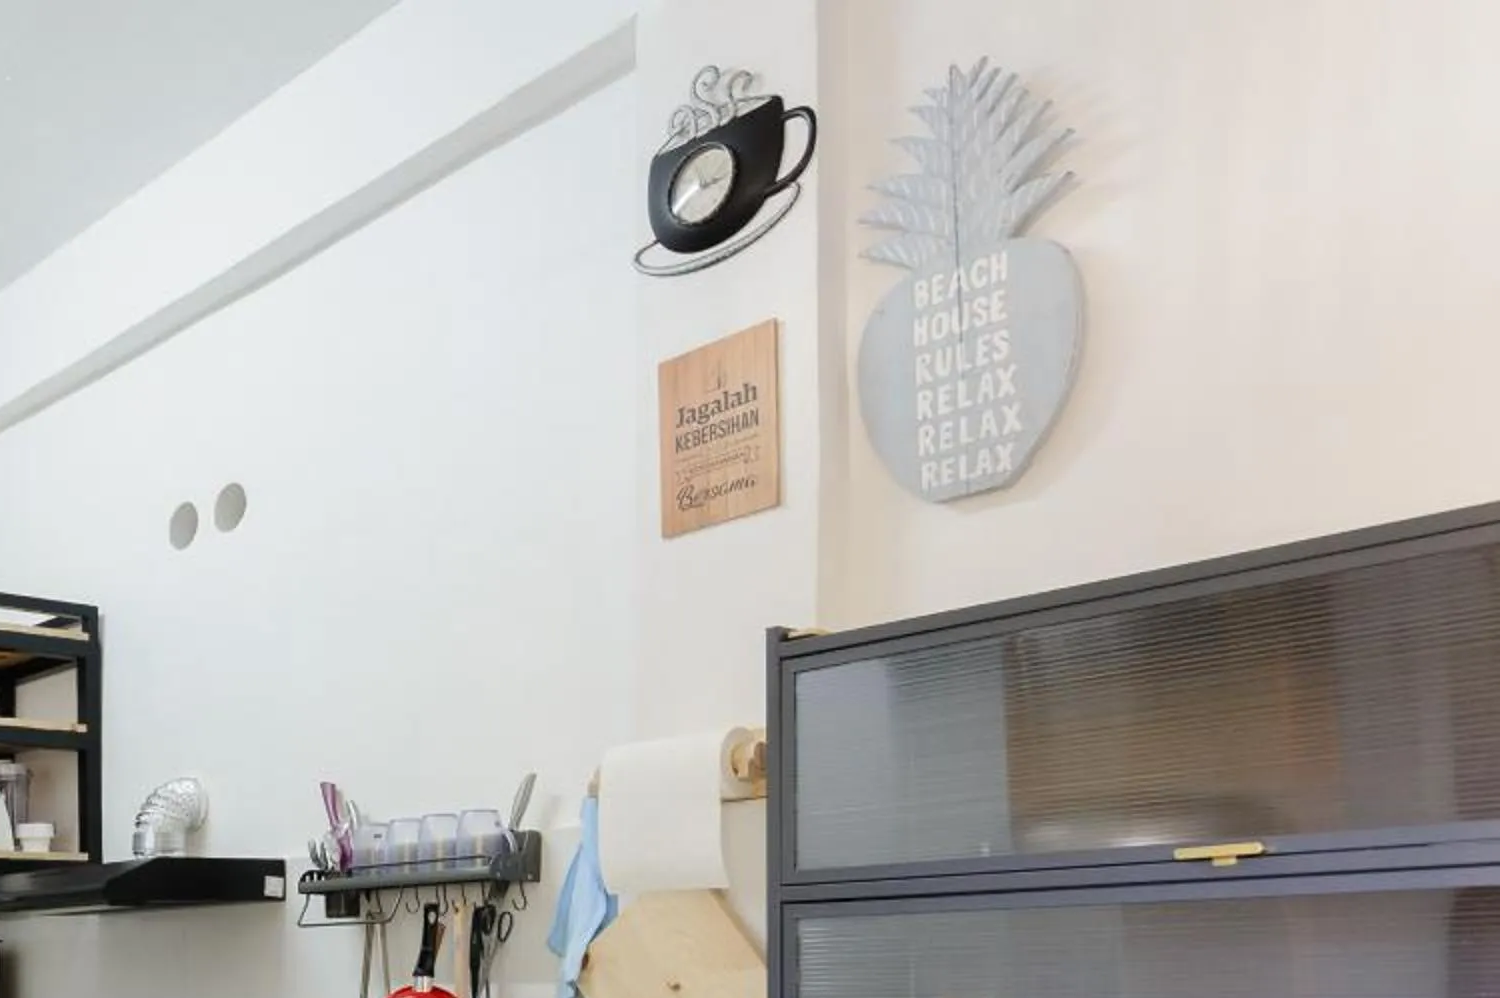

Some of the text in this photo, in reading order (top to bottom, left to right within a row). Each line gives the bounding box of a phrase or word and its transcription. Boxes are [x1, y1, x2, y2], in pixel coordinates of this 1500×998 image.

[913, 251, 1008, 310] BEACH
[913, 289, 1008, 348] HOUSE
[915, 328, 1011, 387] RULES
[675, 382, 758, 429] Jagalah
[917, 363, 1017, 421] RELAX
[675, 407, 760, 454] KEBERSIHAN
[918, 401, 1023, 457] RELAX
[921, 442, 1014, 491] RELAX
